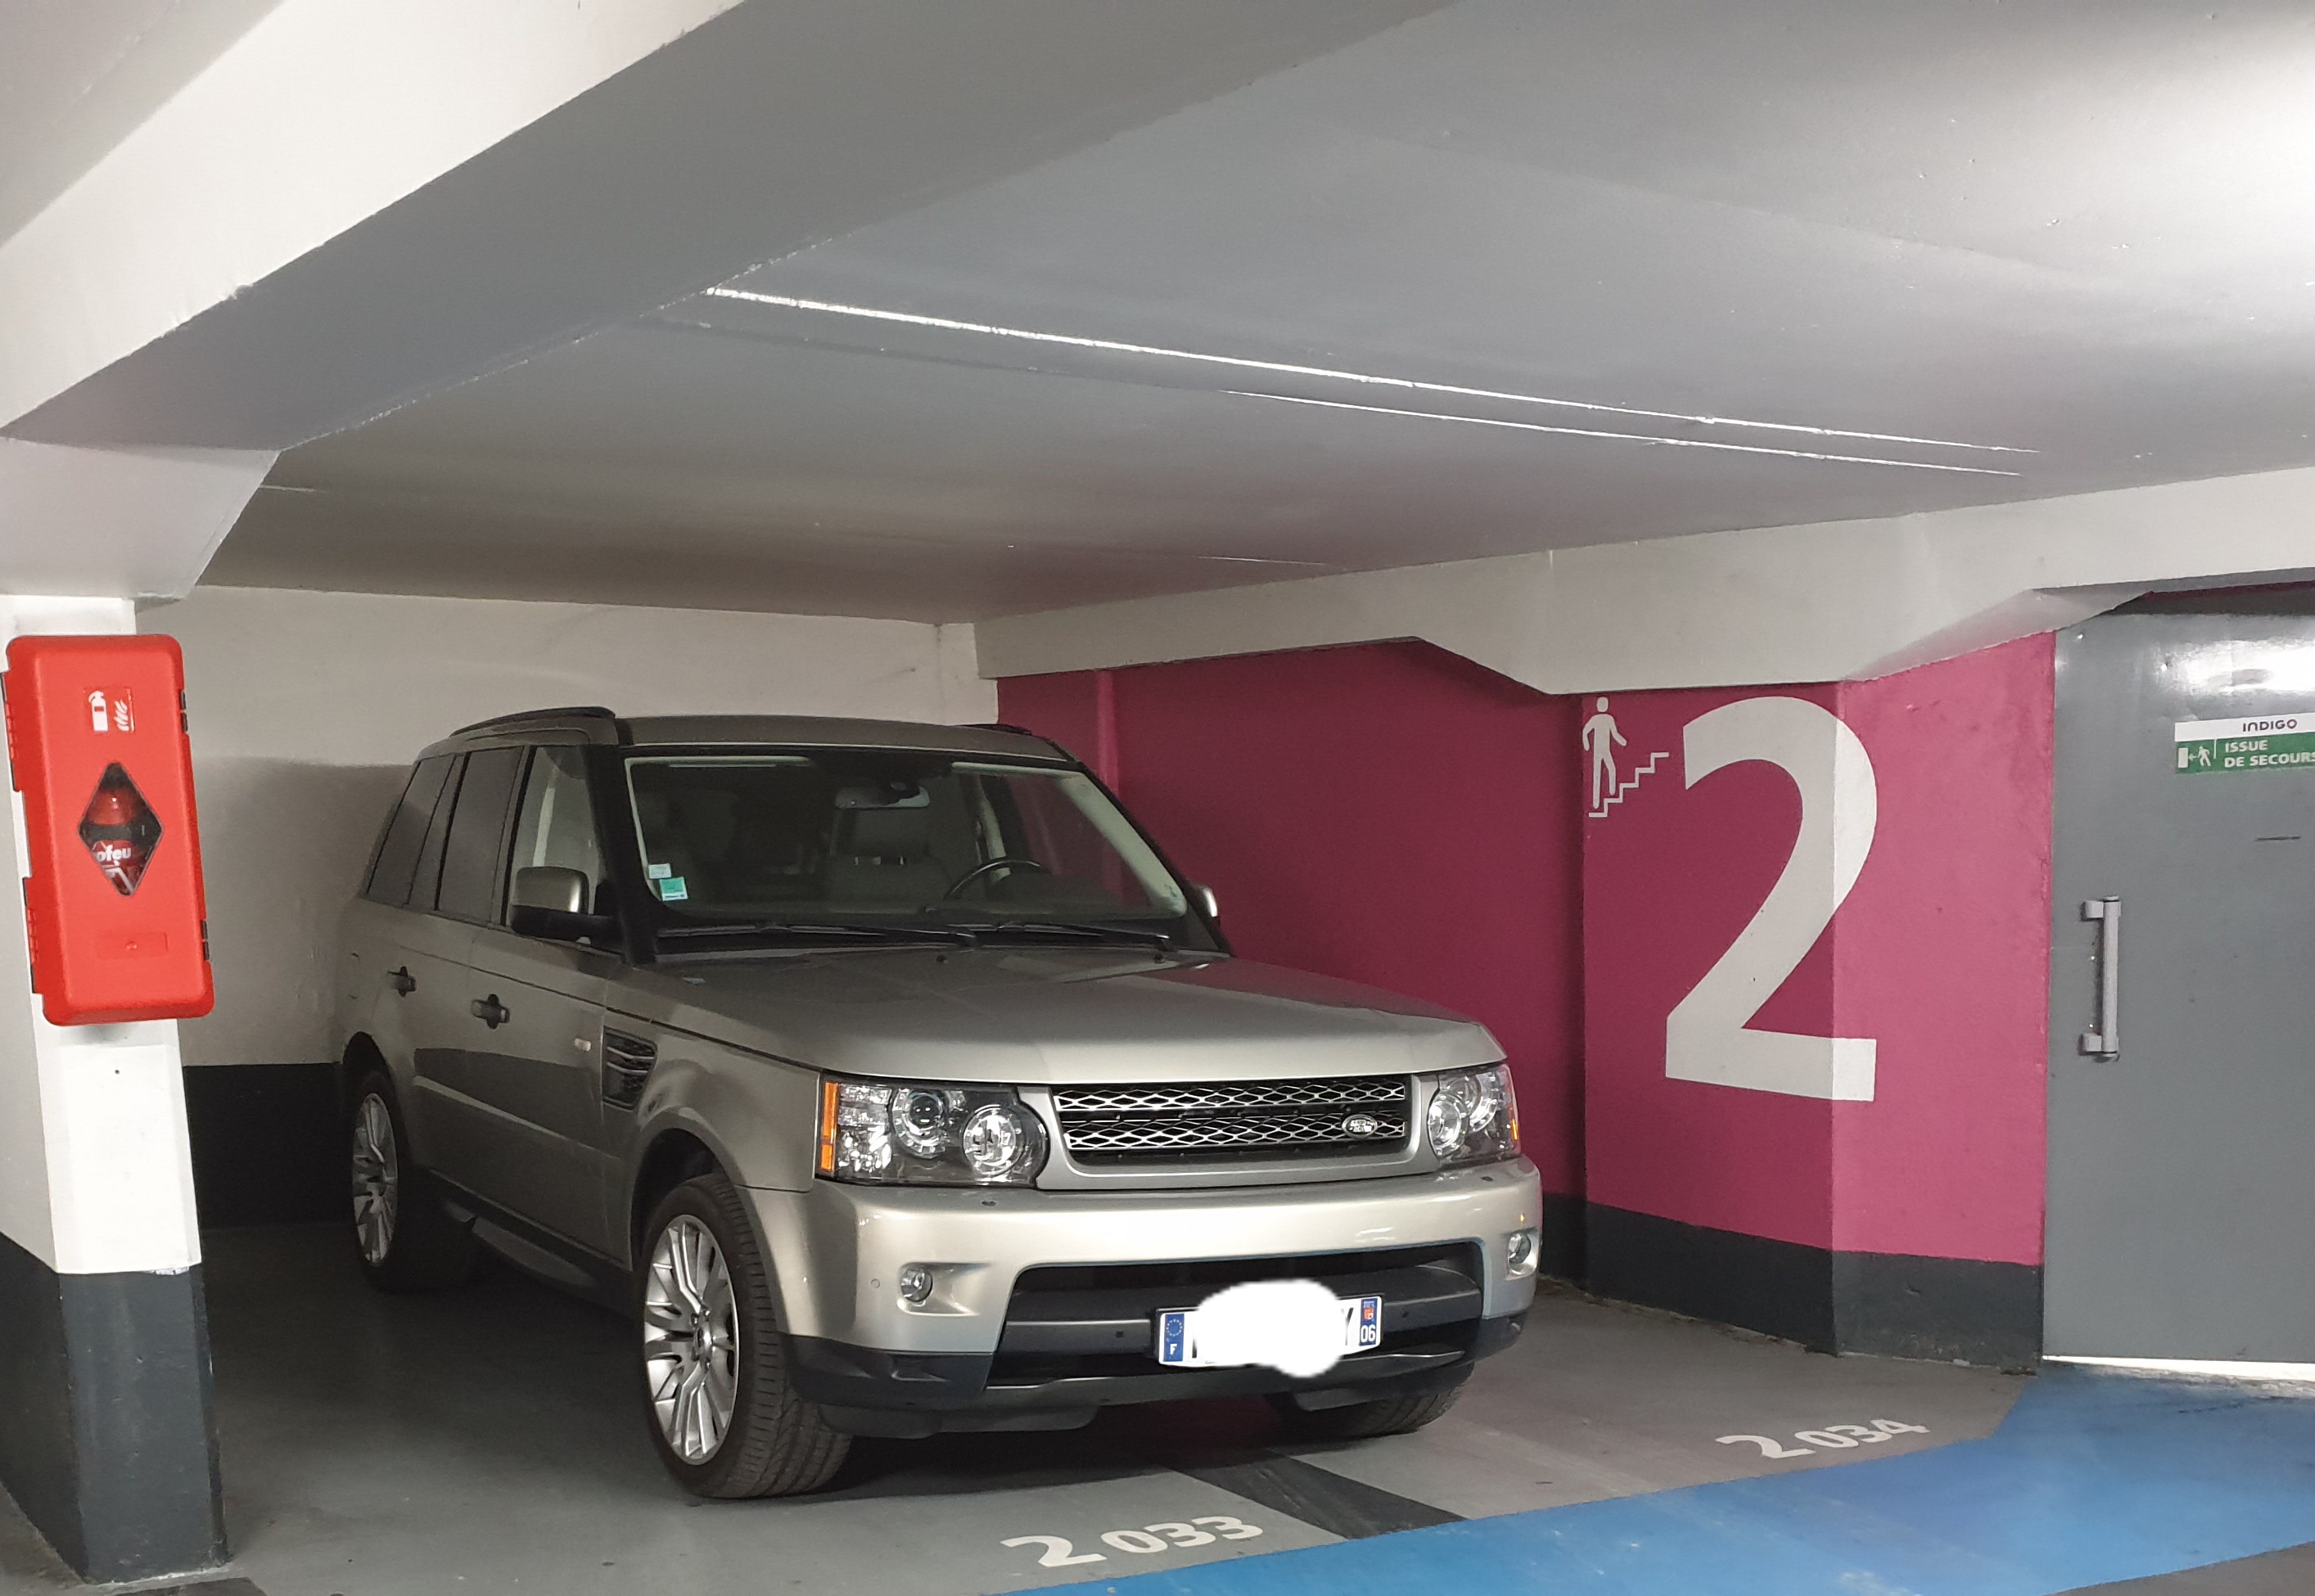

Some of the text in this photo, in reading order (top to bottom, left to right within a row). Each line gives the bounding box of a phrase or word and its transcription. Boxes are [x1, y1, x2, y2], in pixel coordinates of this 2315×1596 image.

[2243, 719, 2298, 733] INDIGO
[2225, 740, 2268, 753] ISSUE
[2224, 756, 2245, 768] DE
[93, 844, 132, 862] ofeu
[1666, 696, 1877, 1102] 2
[1361, 1323, 1376, 1343] 06
[1170, 1343, 1178, 1355] F
